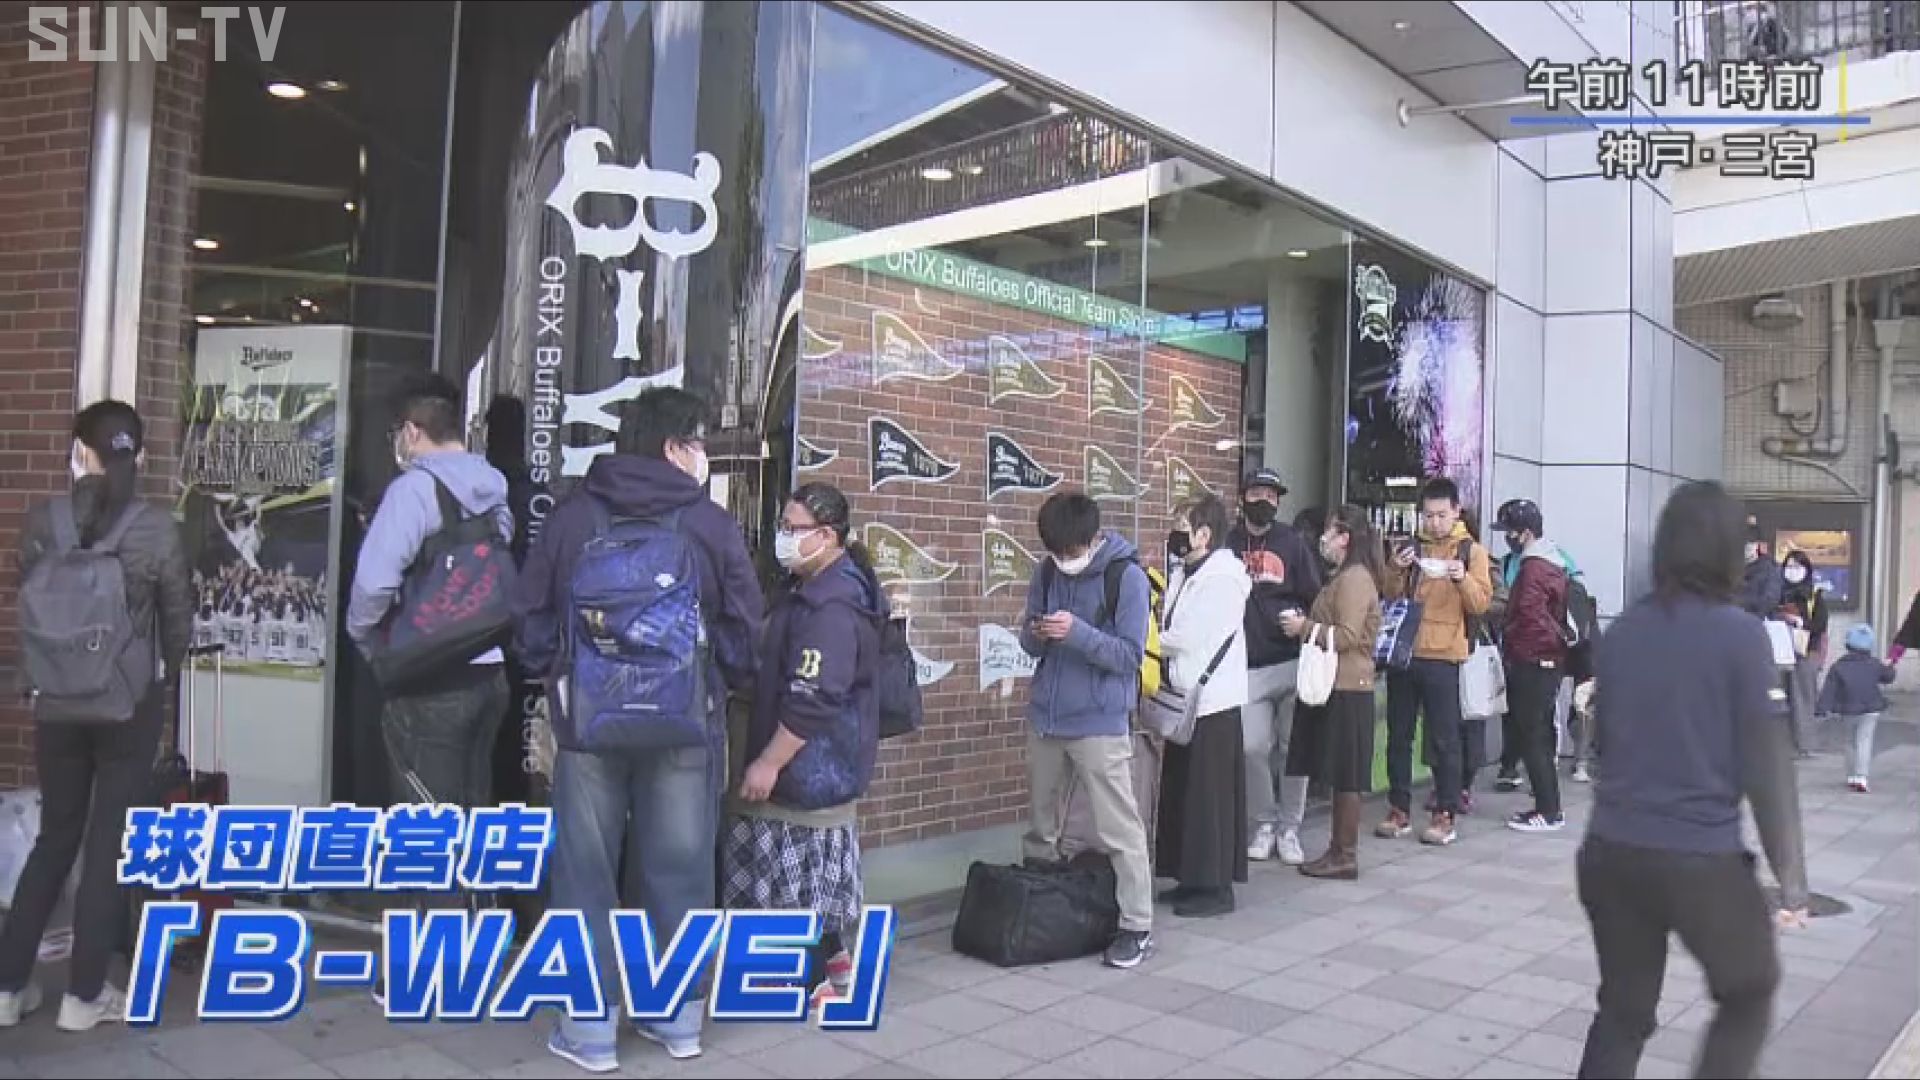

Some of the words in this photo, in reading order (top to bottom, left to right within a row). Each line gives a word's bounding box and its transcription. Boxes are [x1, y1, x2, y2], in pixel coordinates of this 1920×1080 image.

[537, 256, 566, 336] ORIX
[886, 246, 937, 280] ORIX
[941, 258, 1020, 301] Buffaloes
[530, 347, 562, 484] Buffaloes
